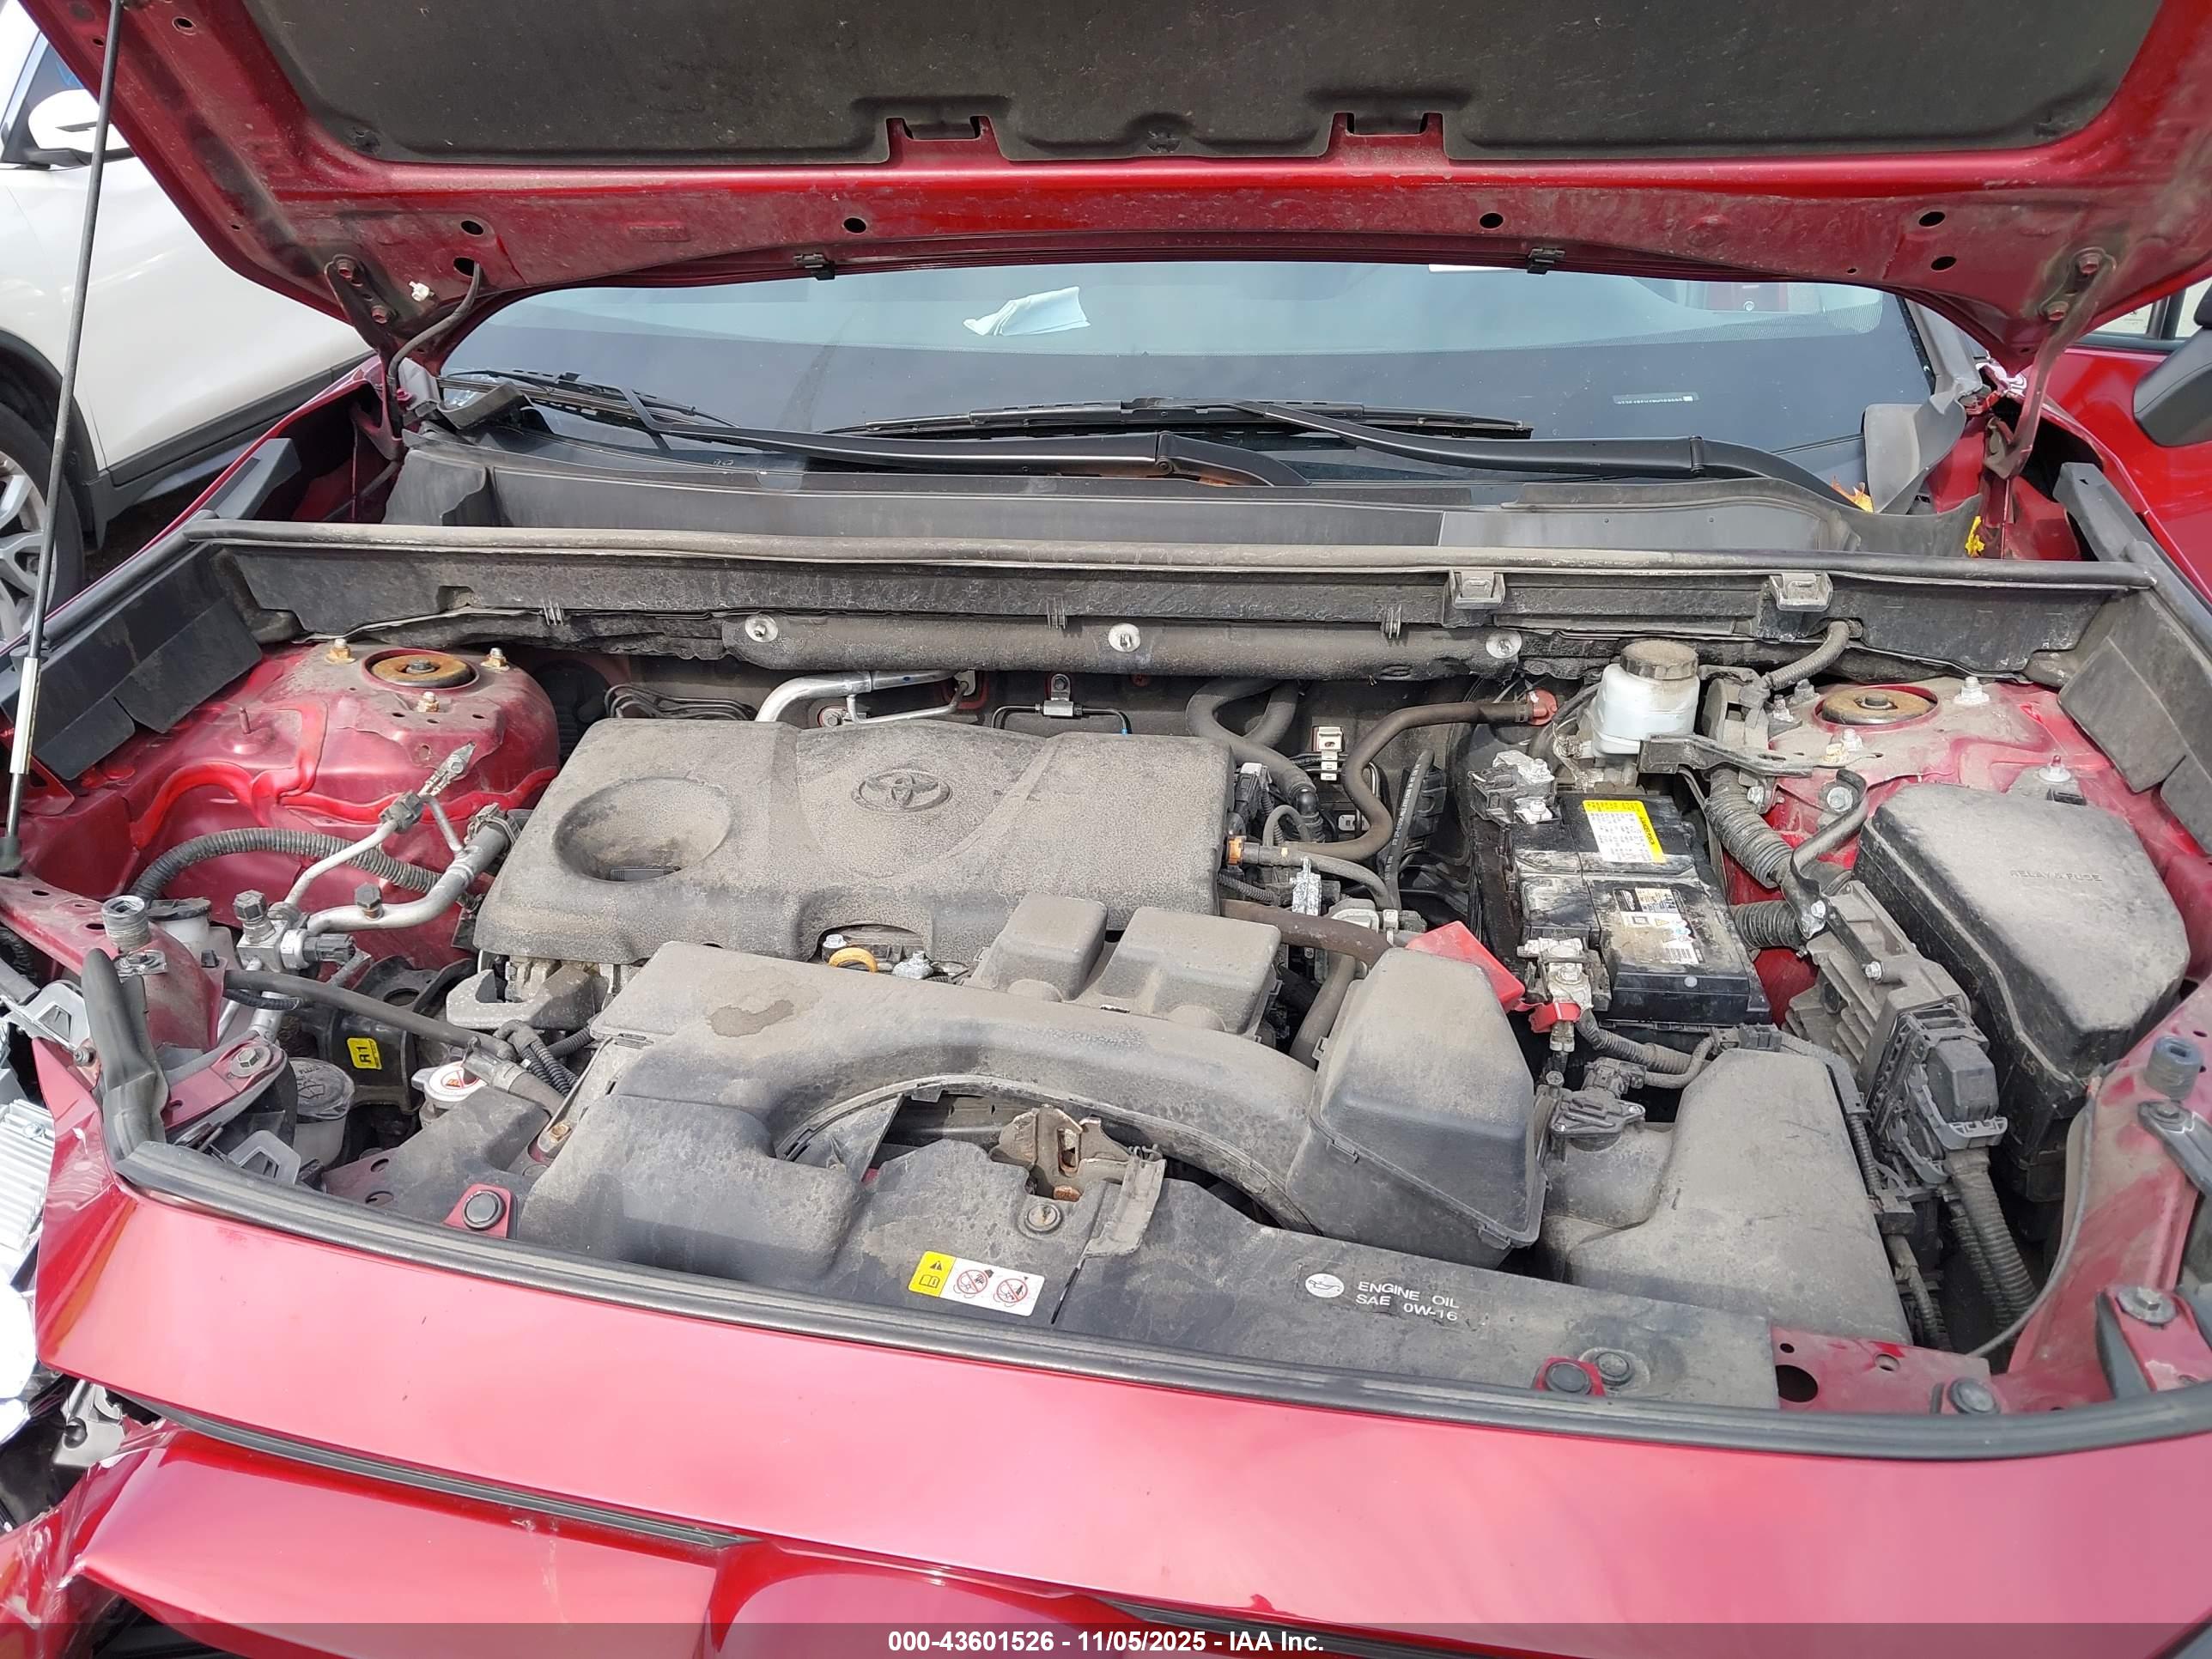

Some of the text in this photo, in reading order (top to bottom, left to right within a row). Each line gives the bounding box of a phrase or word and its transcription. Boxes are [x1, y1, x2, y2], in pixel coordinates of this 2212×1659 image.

[356, 1046, 371, 1063] R1
[1355, 1294, 1458, 1322] SAE 0W-16
[1358, 1281, 1460, 1310] ENGINE OIL
